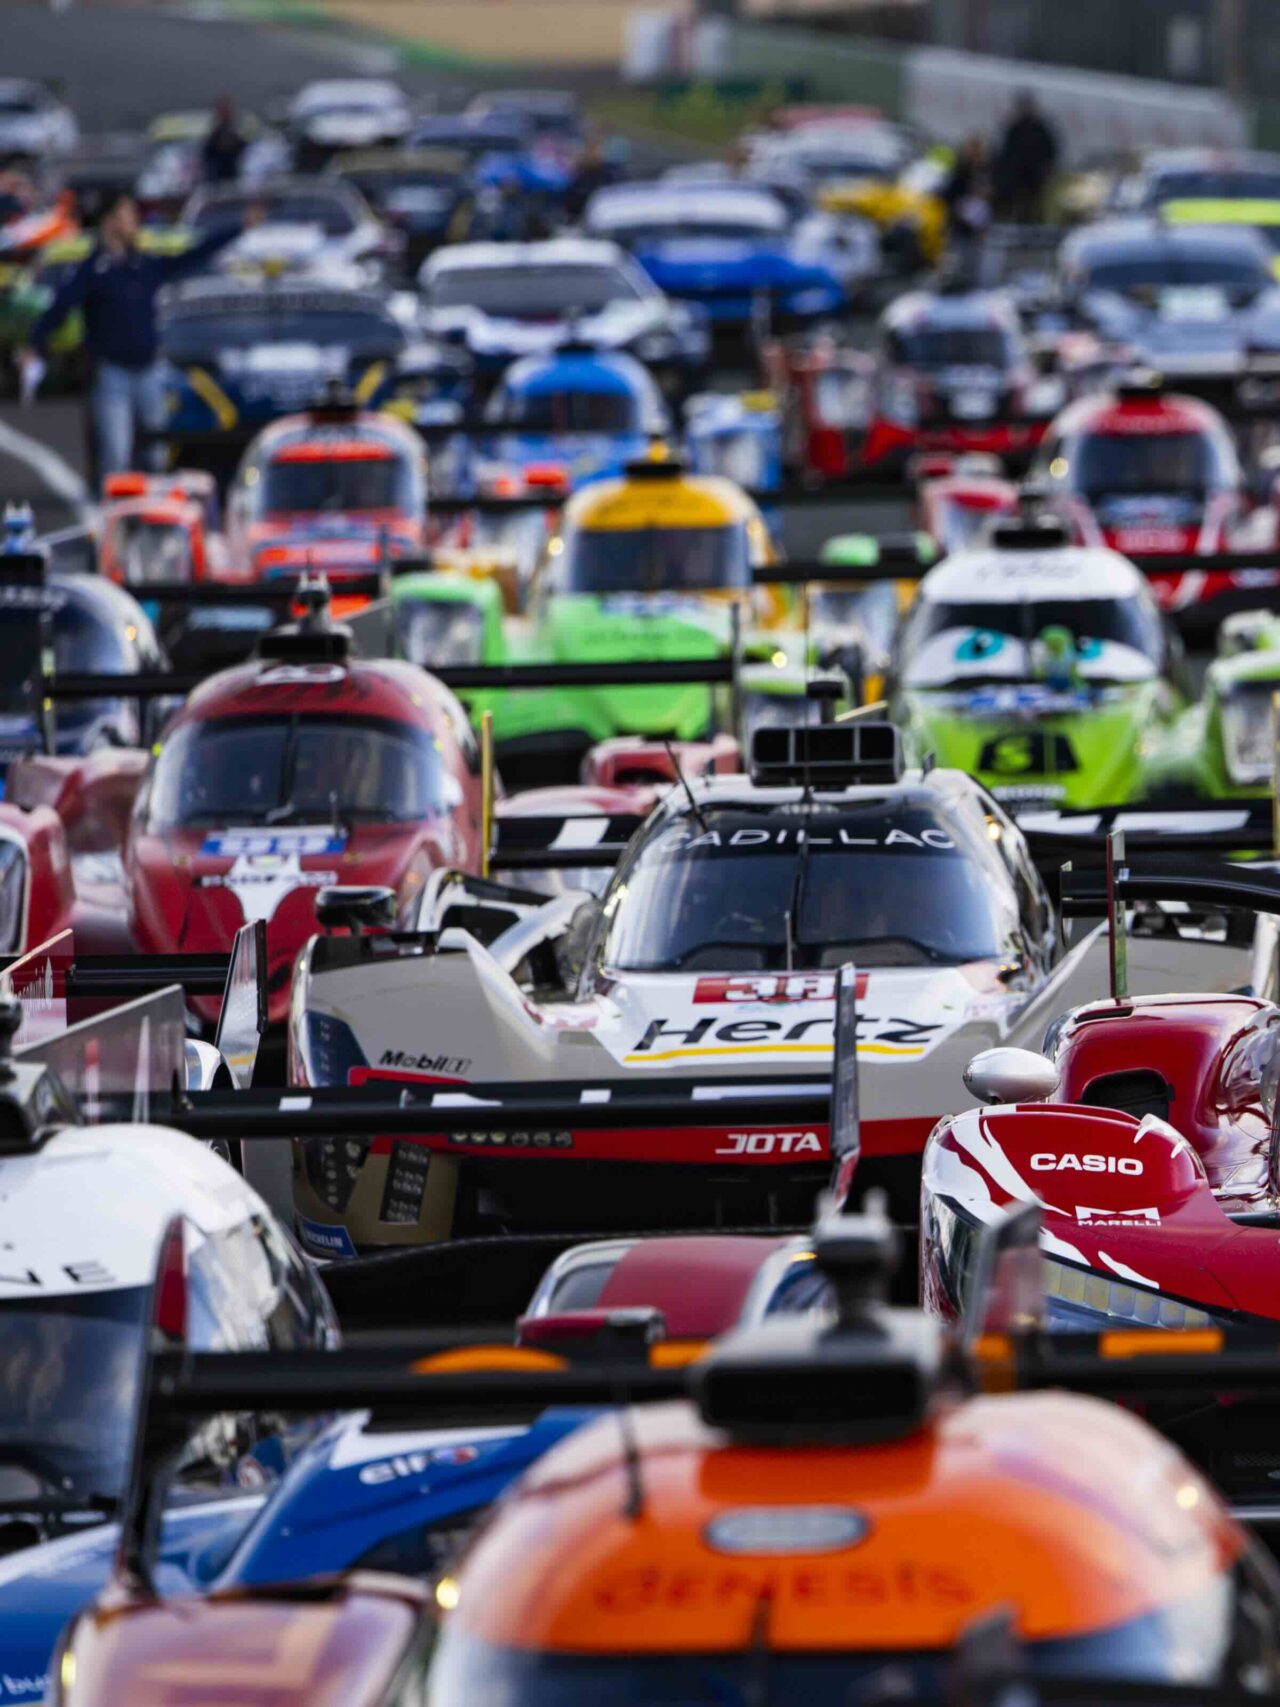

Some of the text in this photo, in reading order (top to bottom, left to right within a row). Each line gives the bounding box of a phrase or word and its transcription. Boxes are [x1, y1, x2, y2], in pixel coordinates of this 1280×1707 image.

[667, 828, 956, 850] CADILLAC
[379, 1048, 449, 1072] Mobil
[715, 1132, 823, 1154] JOTA
[1030, 1153, 1144, 1176] CASIO
[1078, 1219, 1162, 1227] MARELLI
[359, 1453, 428, 1485] elf
